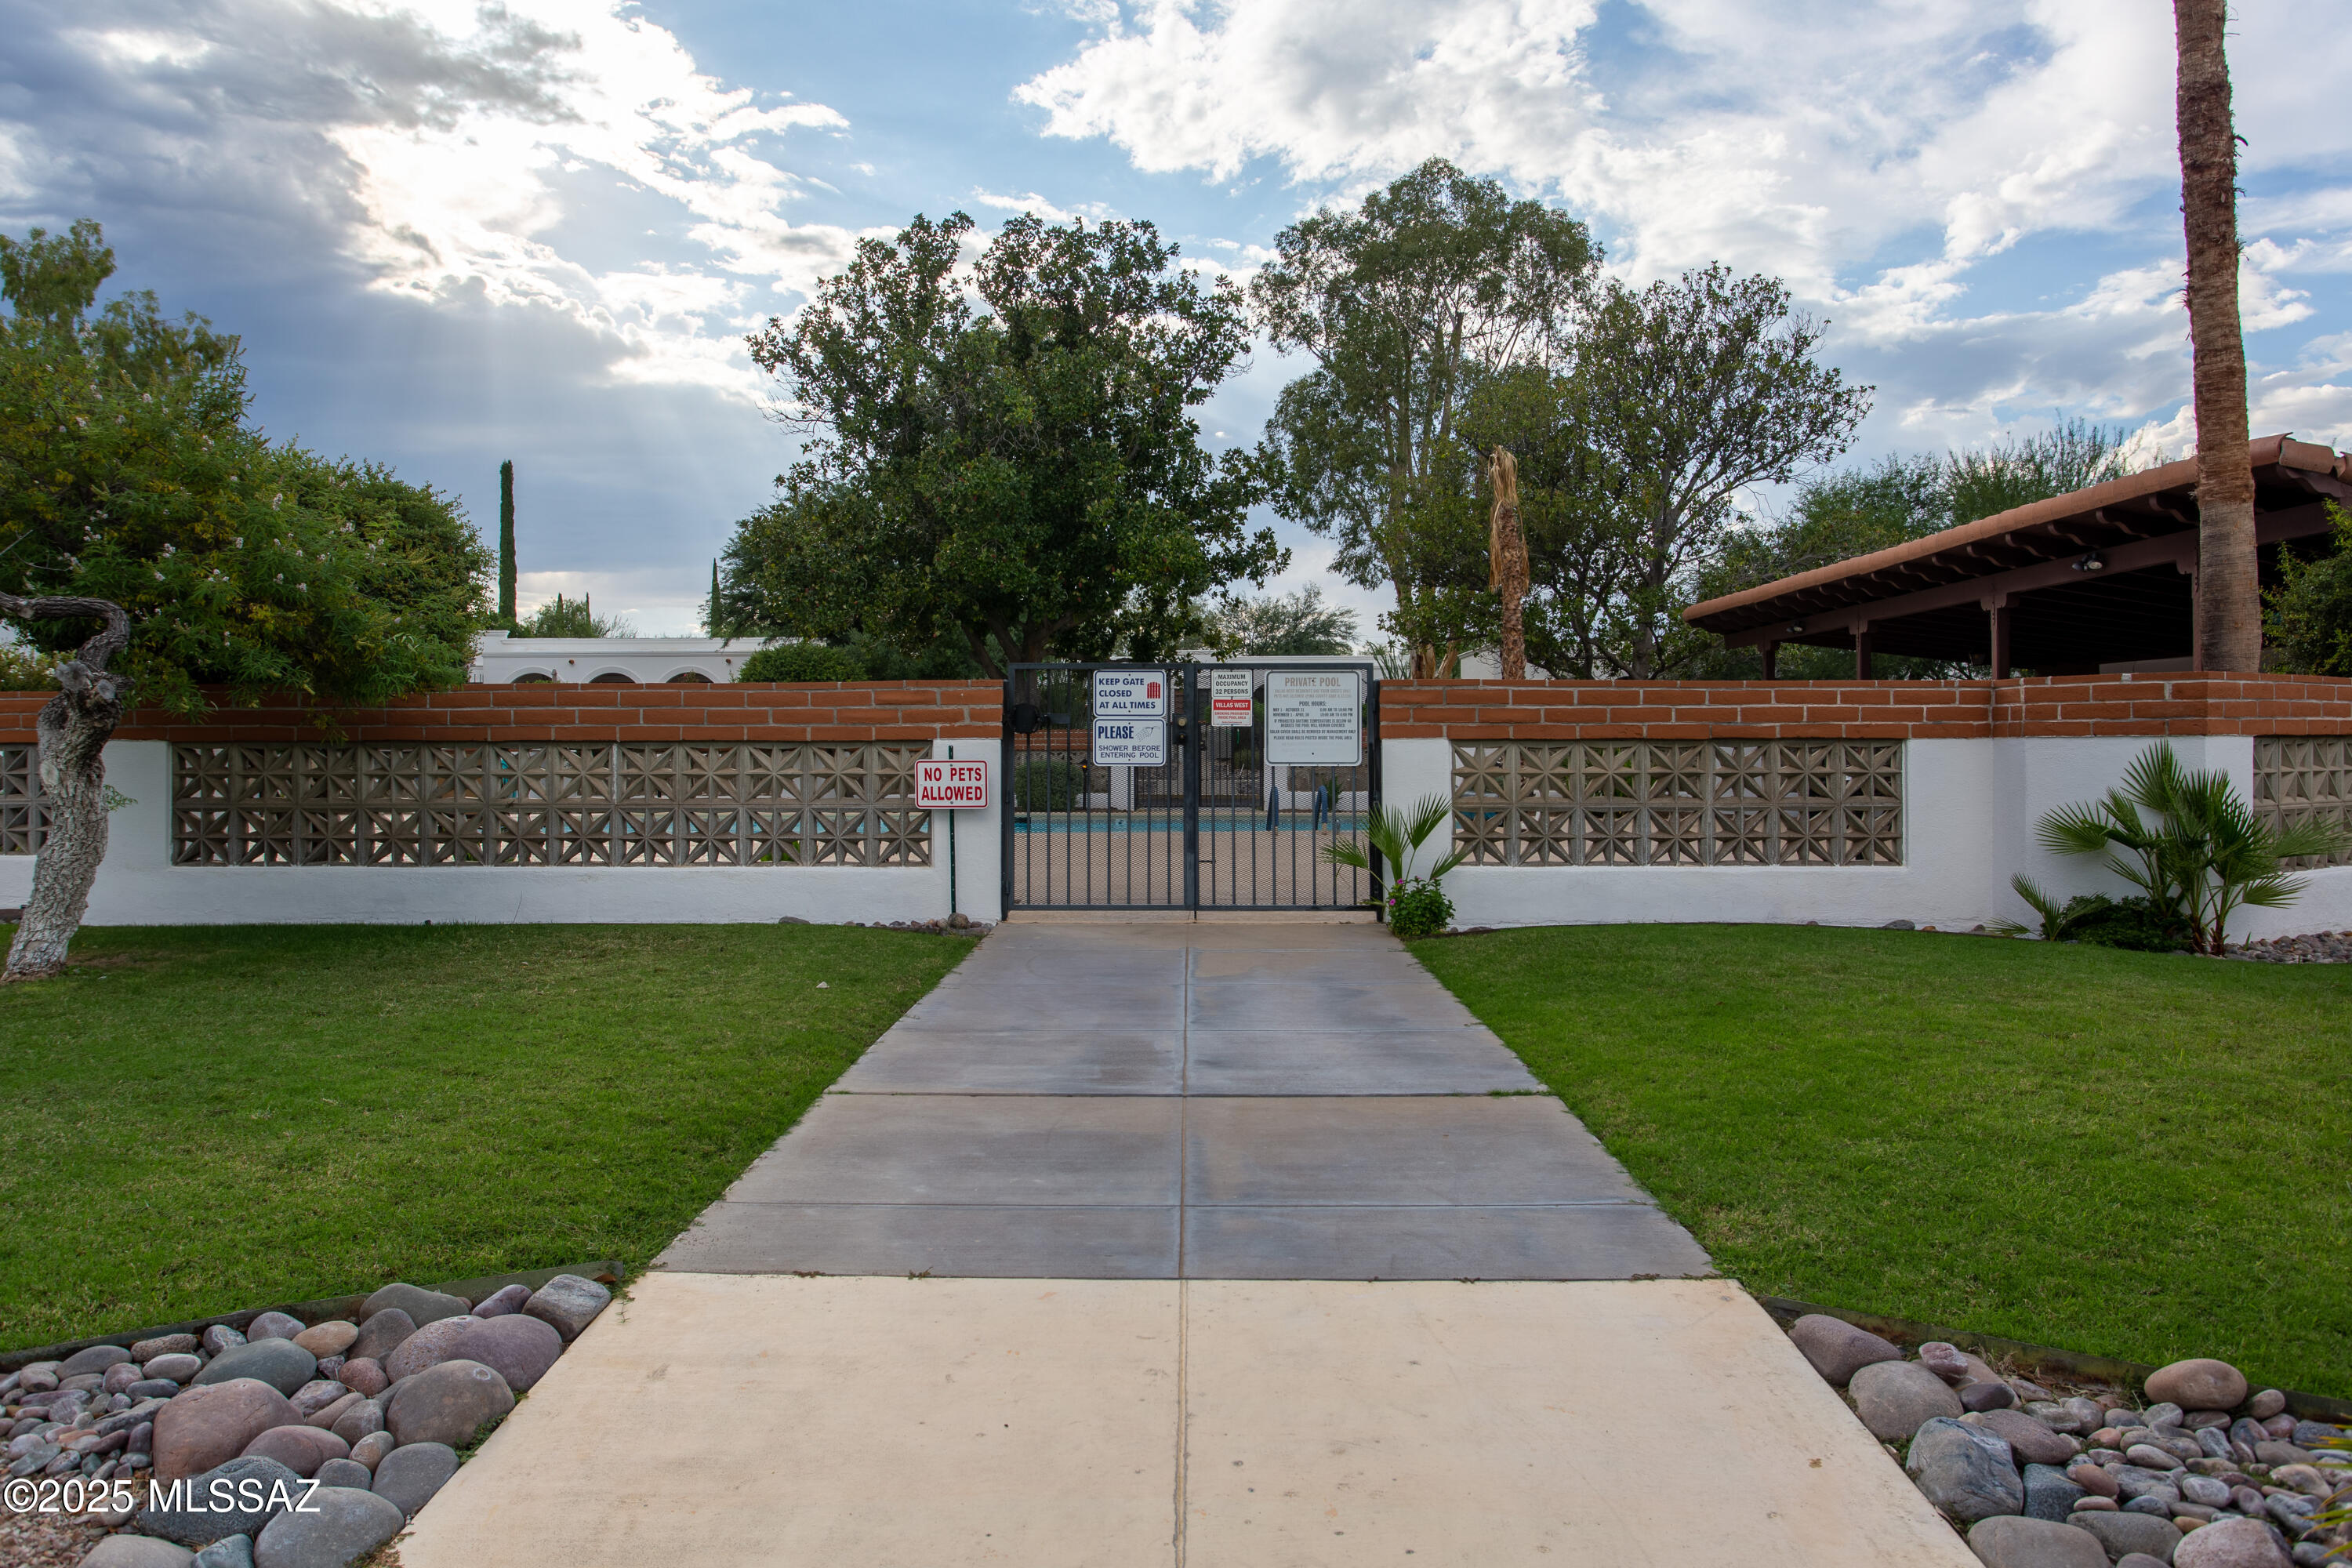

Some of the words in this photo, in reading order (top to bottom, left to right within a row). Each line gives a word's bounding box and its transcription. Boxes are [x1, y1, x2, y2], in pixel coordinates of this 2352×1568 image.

[1285, 677, 1317, 686] PRIVATE
[1319, 677, 1341, 686] POOL
[1098, 726, 1134, 739] PLEASE
[924, 768, 942, 781] NO
[950, 768, 982, 781] PETS
[921, 786, 982, 800] ALLOWED
